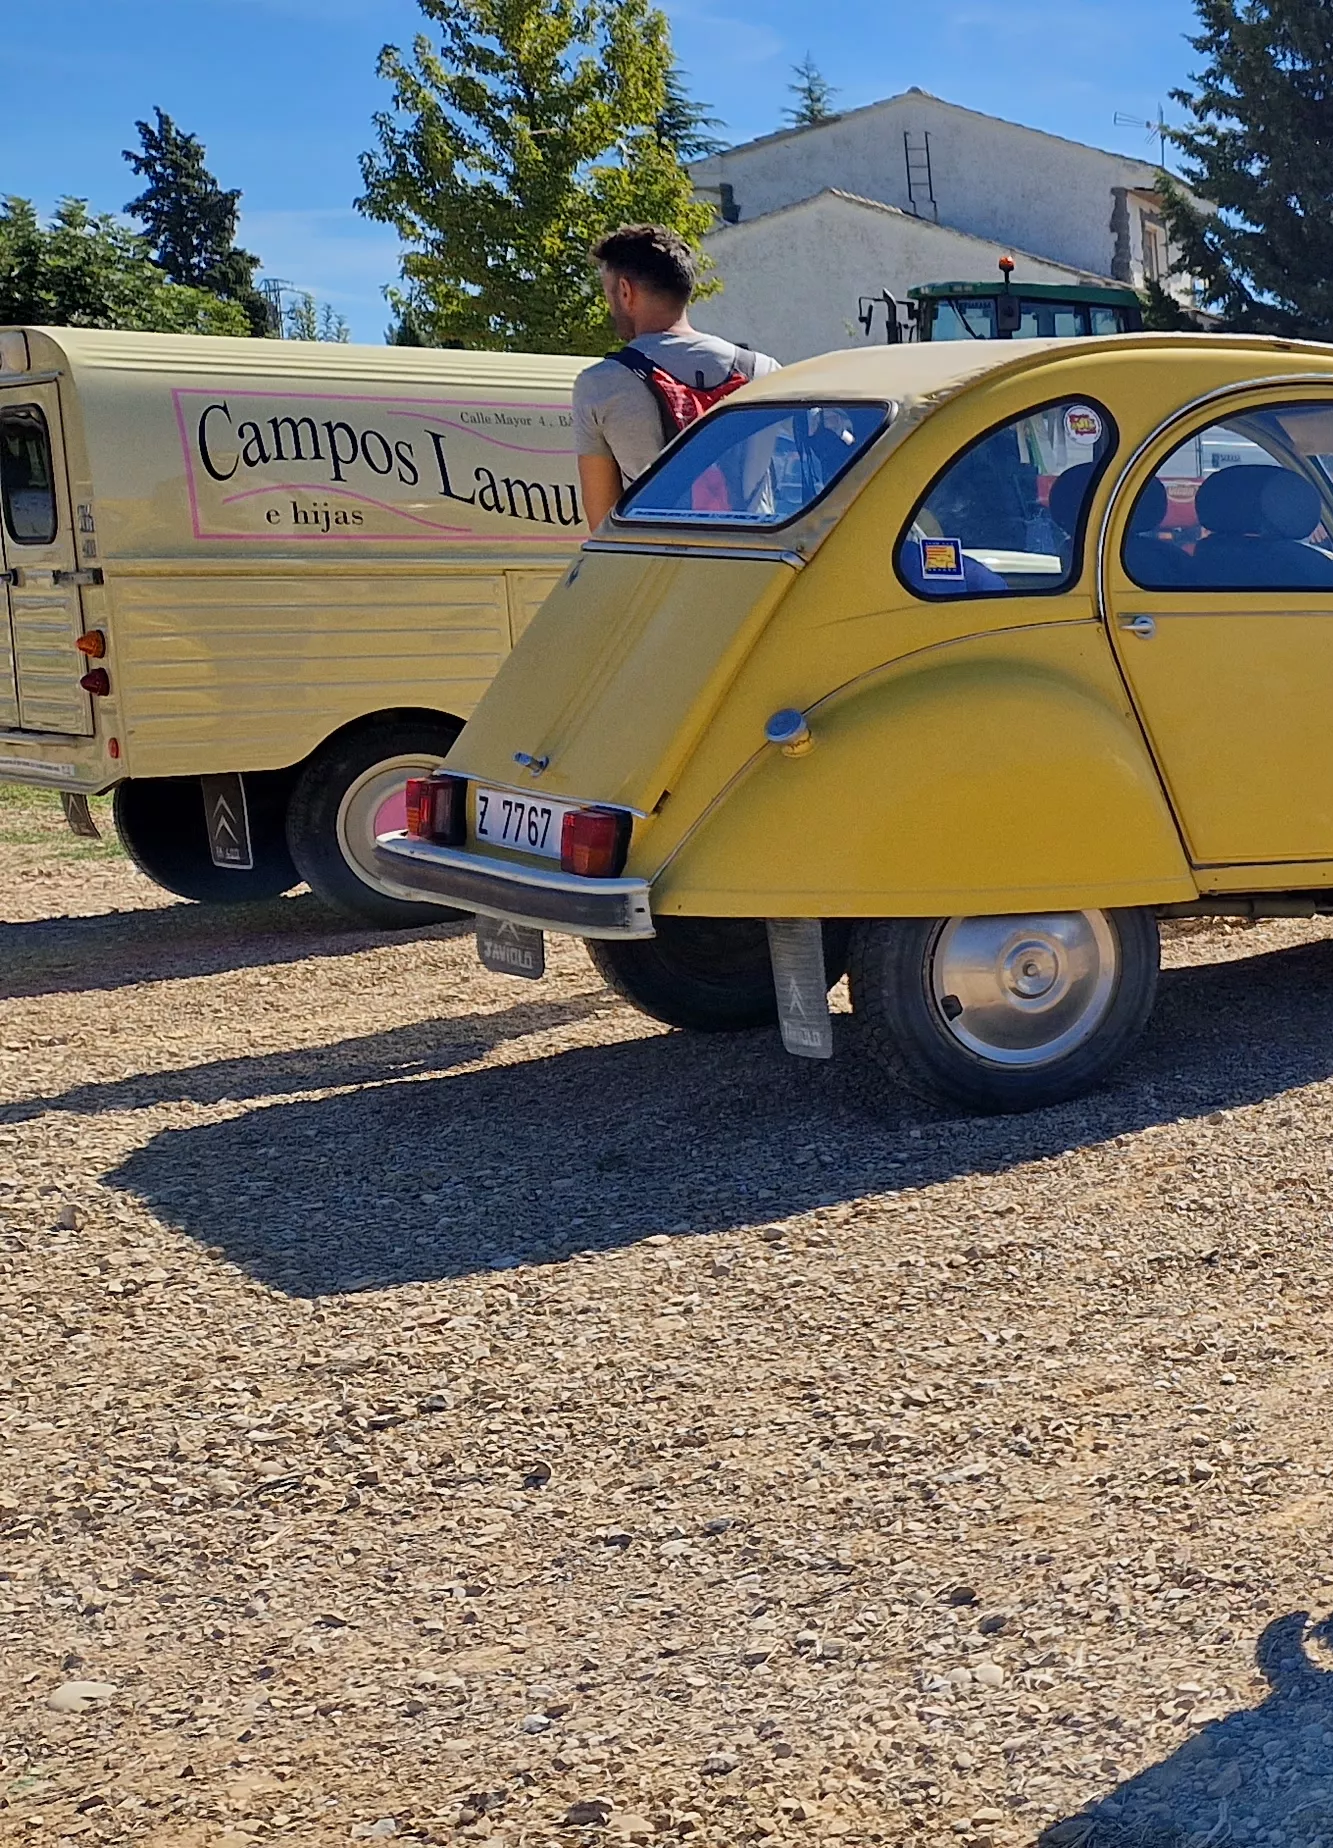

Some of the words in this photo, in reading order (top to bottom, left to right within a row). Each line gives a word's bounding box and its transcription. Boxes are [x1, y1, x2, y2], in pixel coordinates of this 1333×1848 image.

[460, 411, 492, 424] Calle
[494, 412, 533, 428] Mayor
[199, 400, 420, 486] Campos
[424, 428, 584, 527] Lamu
[265, 506, 281, 525] e
[292, 500, 364, 532] hijas
[478, 795, 489, 835] Z
[502, 799, 552, 849] 7767
